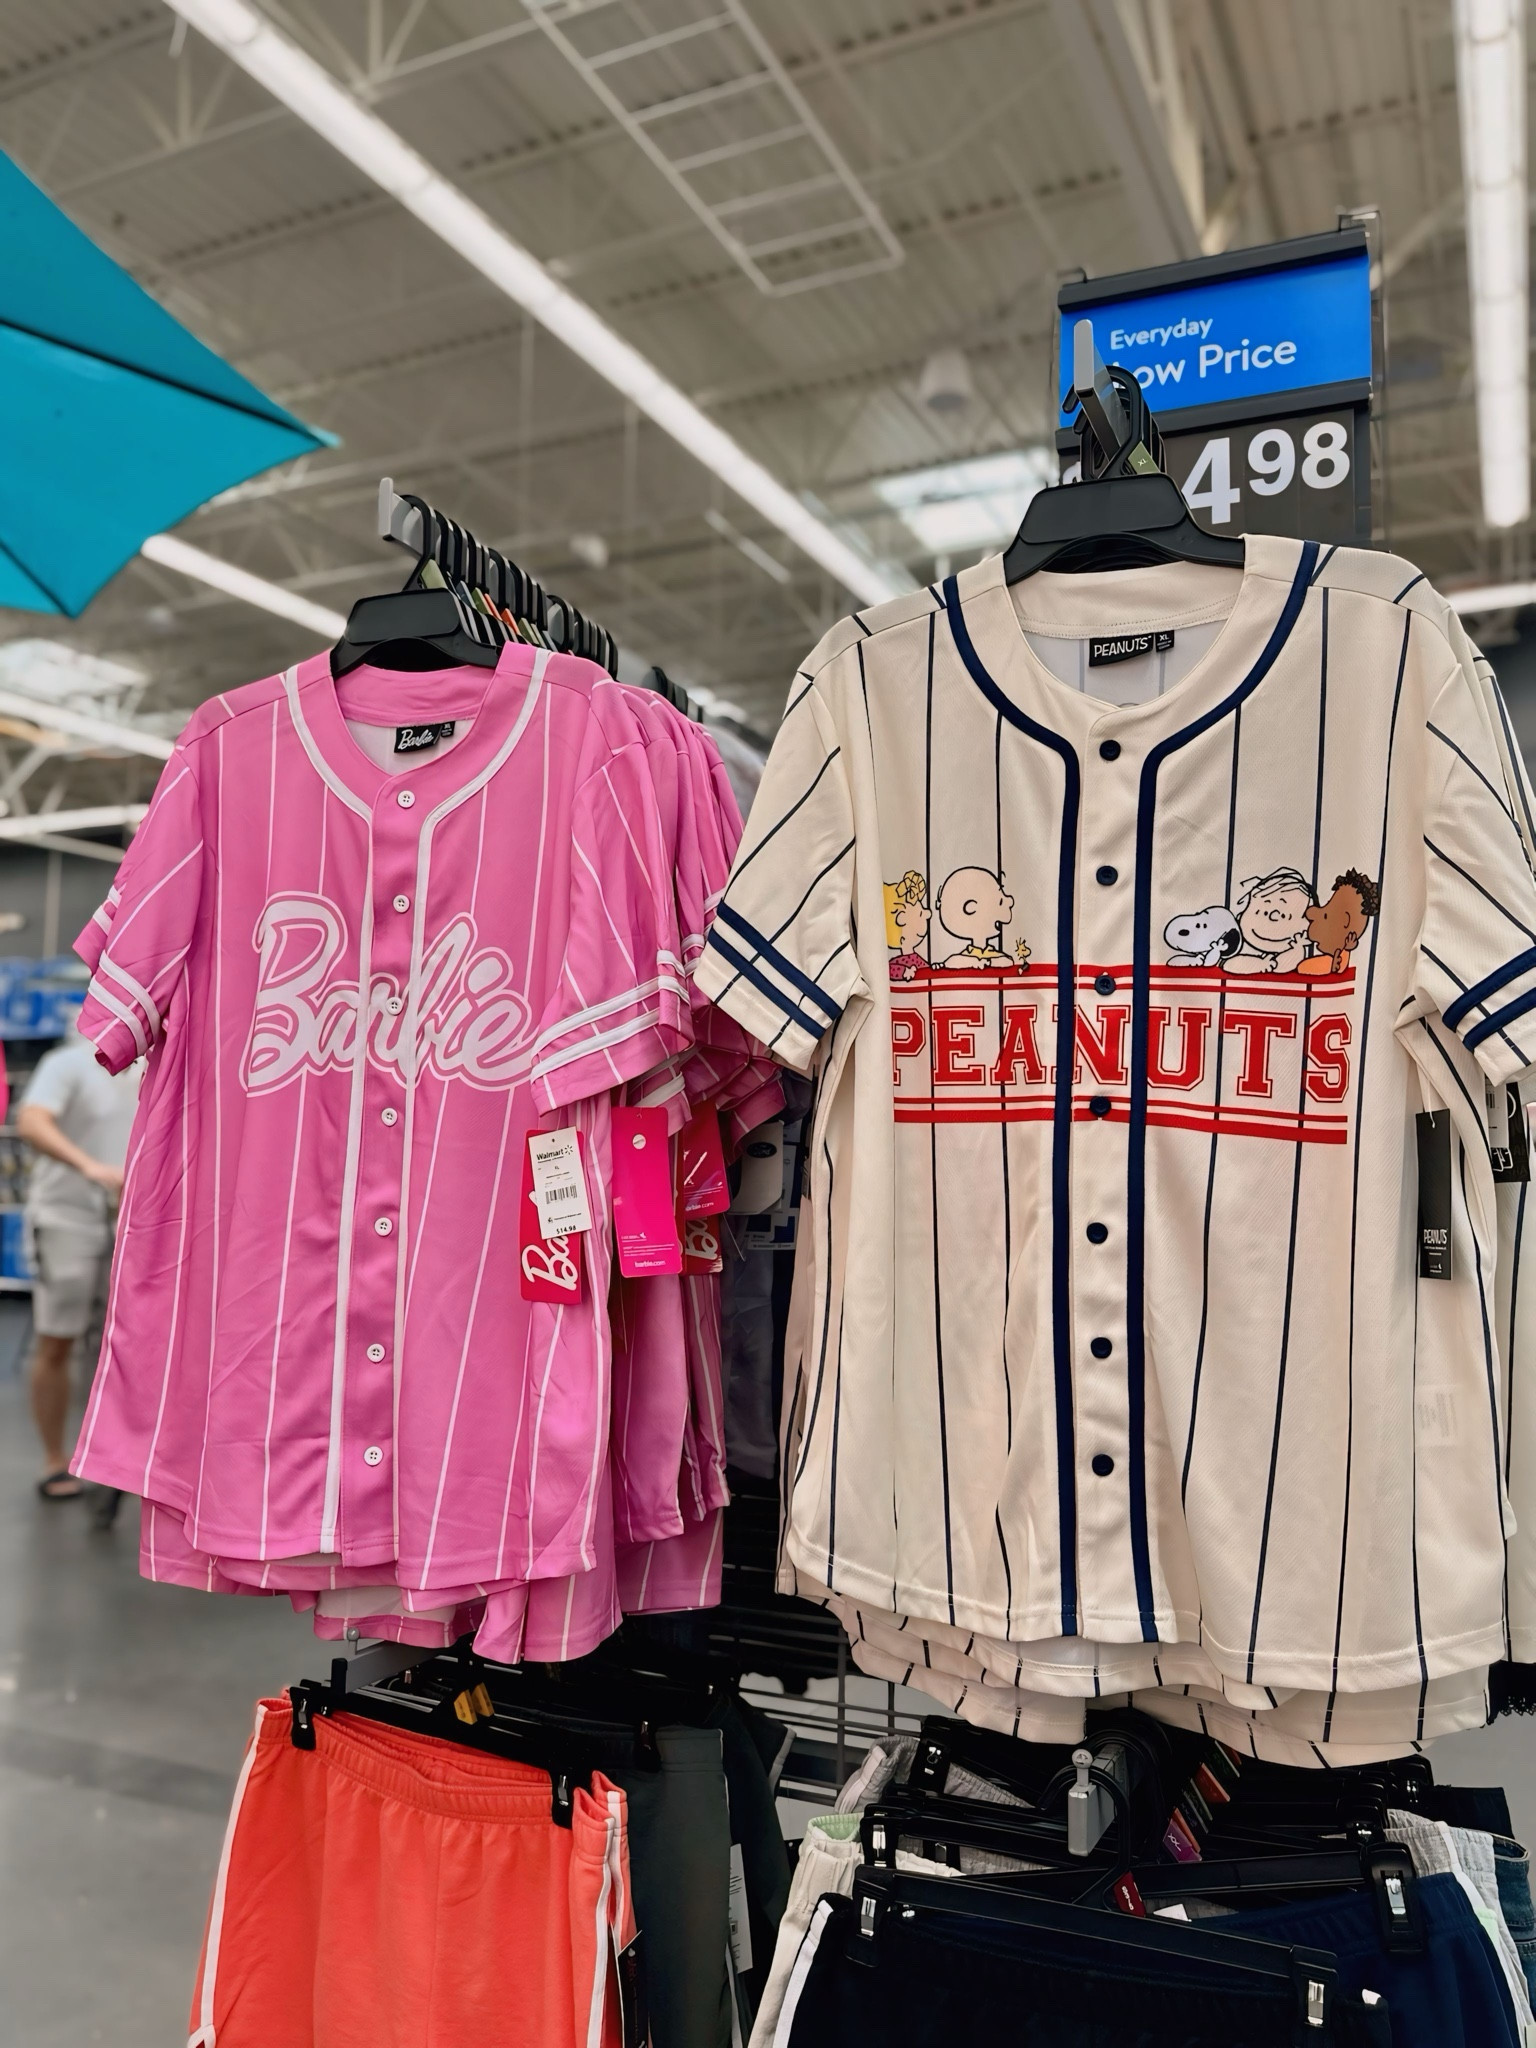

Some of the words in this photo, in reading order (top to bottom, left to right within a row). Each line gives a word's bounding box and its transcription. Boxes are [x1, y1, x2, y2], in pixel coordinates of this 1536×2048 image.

[1110, 317, 1213, 350] Everyday
[1199, 338, 1297, 379] Price
[1093, 637, 1149, 658] PEANUTS
[1159, 634, 1170, 642] XL
[397, 728, 434, 750] Barbie
[238, 889, 540, 1098] Barbie
[890, 1003, 1354, 1104] PEANUTS
[536, 1148, 564, 1161] Walmart
[556, 1224, 577, 1235] $14.98
[1423, 1229, 1448, 1244] PEANUTS
